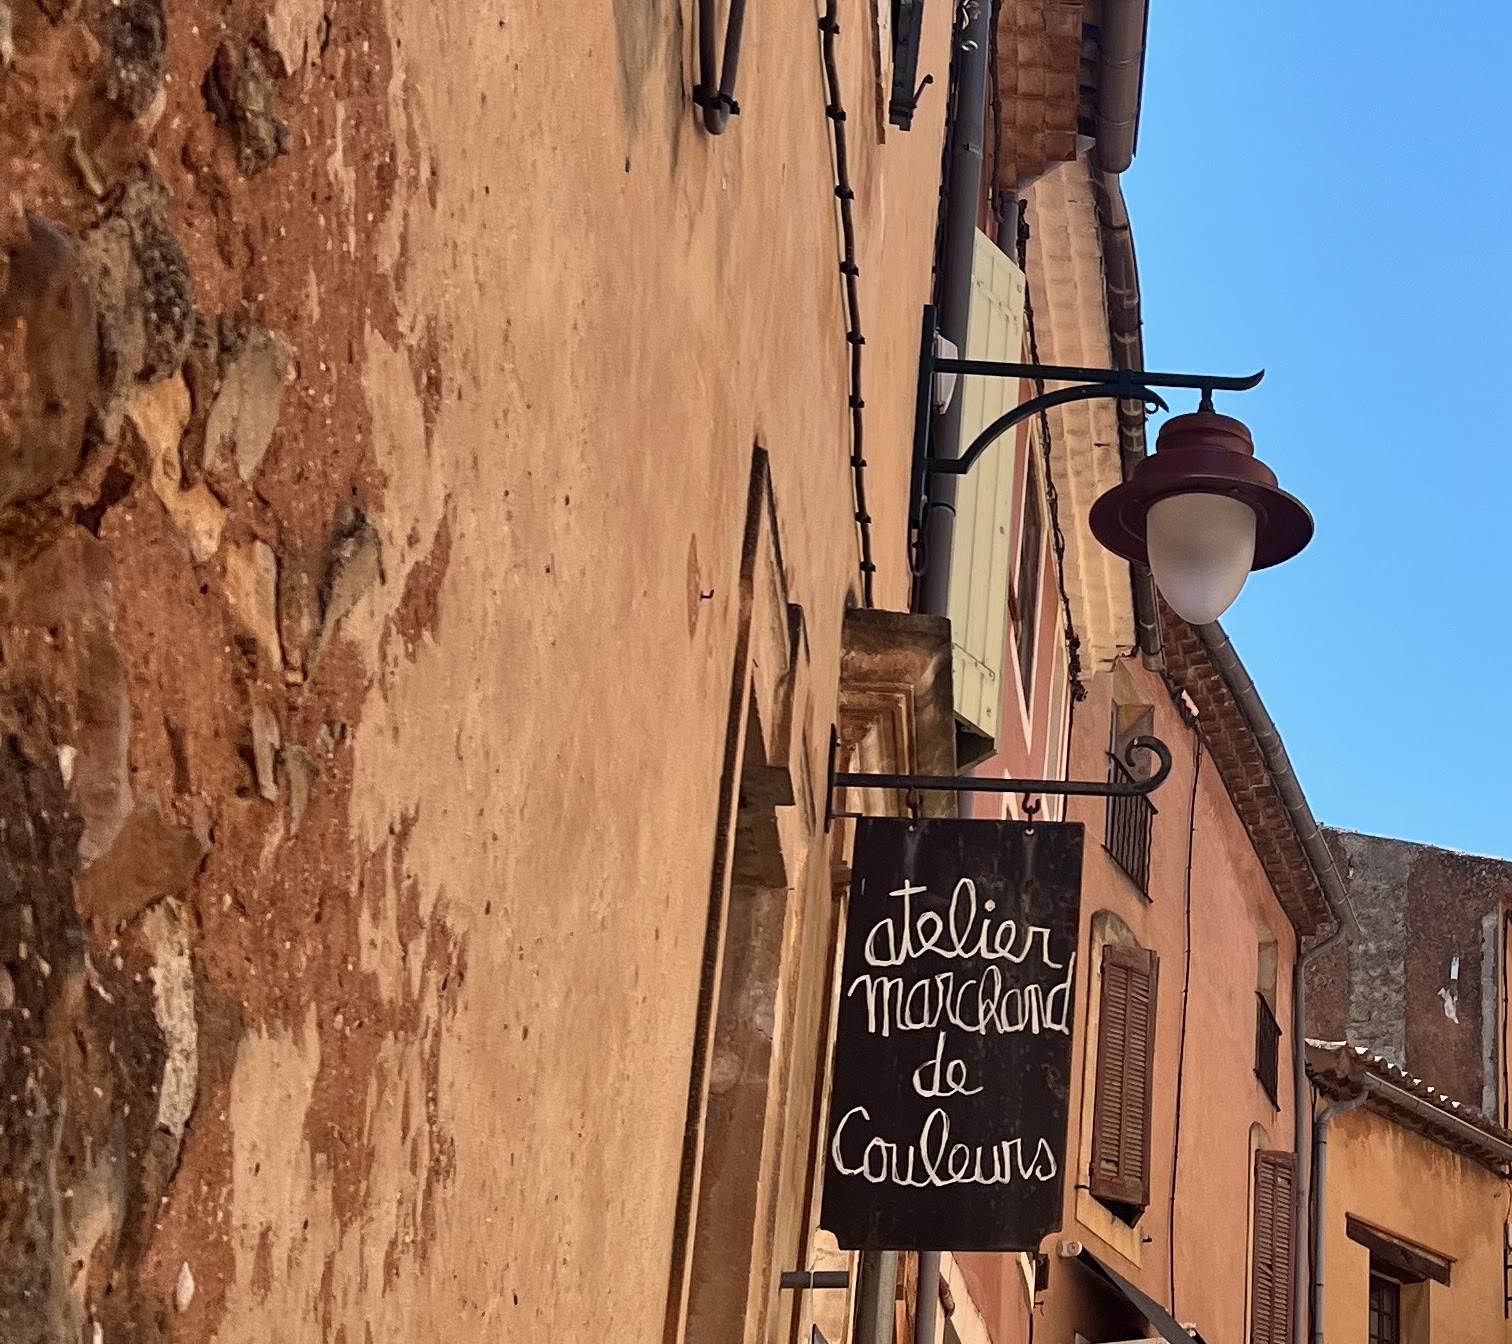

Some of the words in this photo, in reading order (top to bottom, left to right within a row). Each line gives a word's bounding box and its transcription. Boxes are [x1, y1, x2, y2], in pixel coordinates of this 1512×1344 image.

[864, 877, 1064, 968] atelier
[847, 951, 1077, 1037] marchand
[912, 1030, 983, 1097] de
